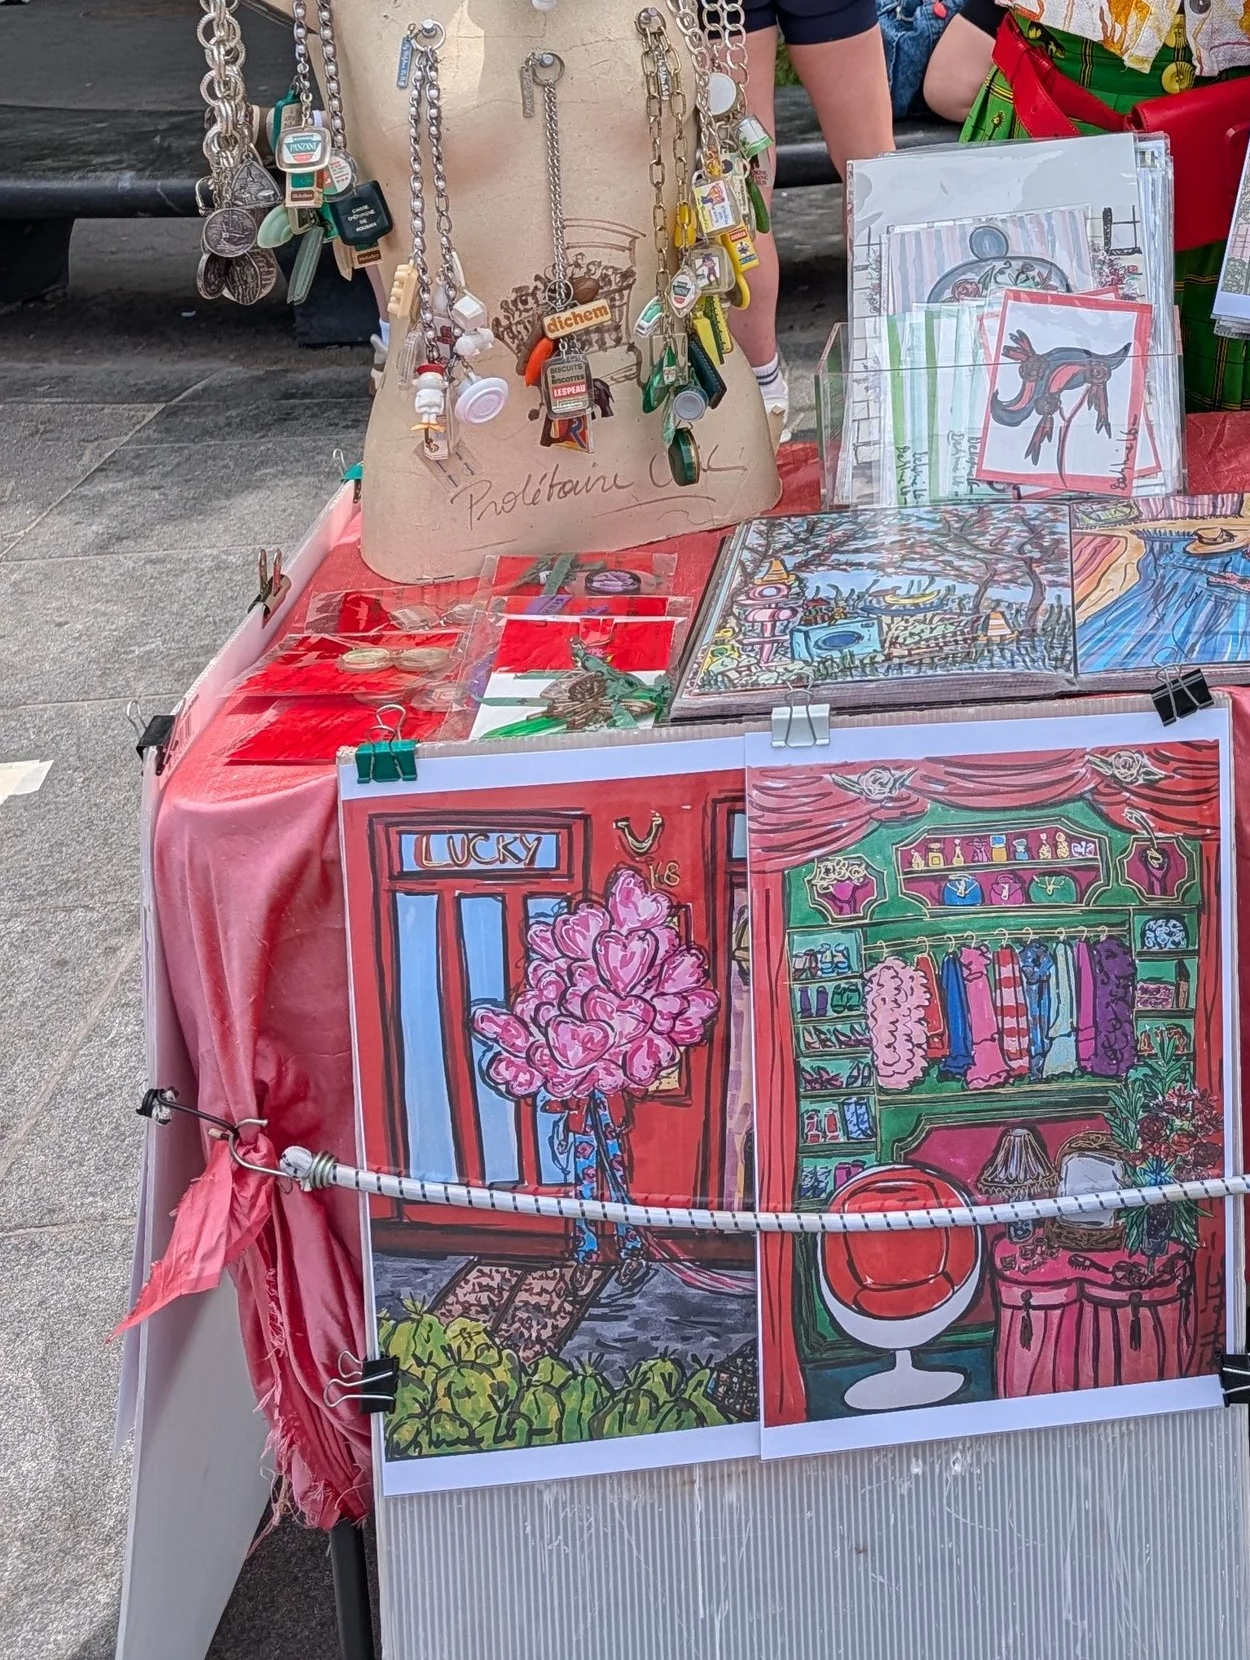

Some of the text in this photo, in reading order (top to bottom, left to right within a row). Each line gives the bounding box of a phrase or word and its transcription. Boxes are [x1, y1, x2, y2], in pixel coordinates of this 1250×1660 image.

[546, 304, 609, 334] dichem
[550, 363, 583, 374] BISCUITS
[553, 384, 586, 397] LESPEAU
[416, 833, 543, 869] LUCKY
